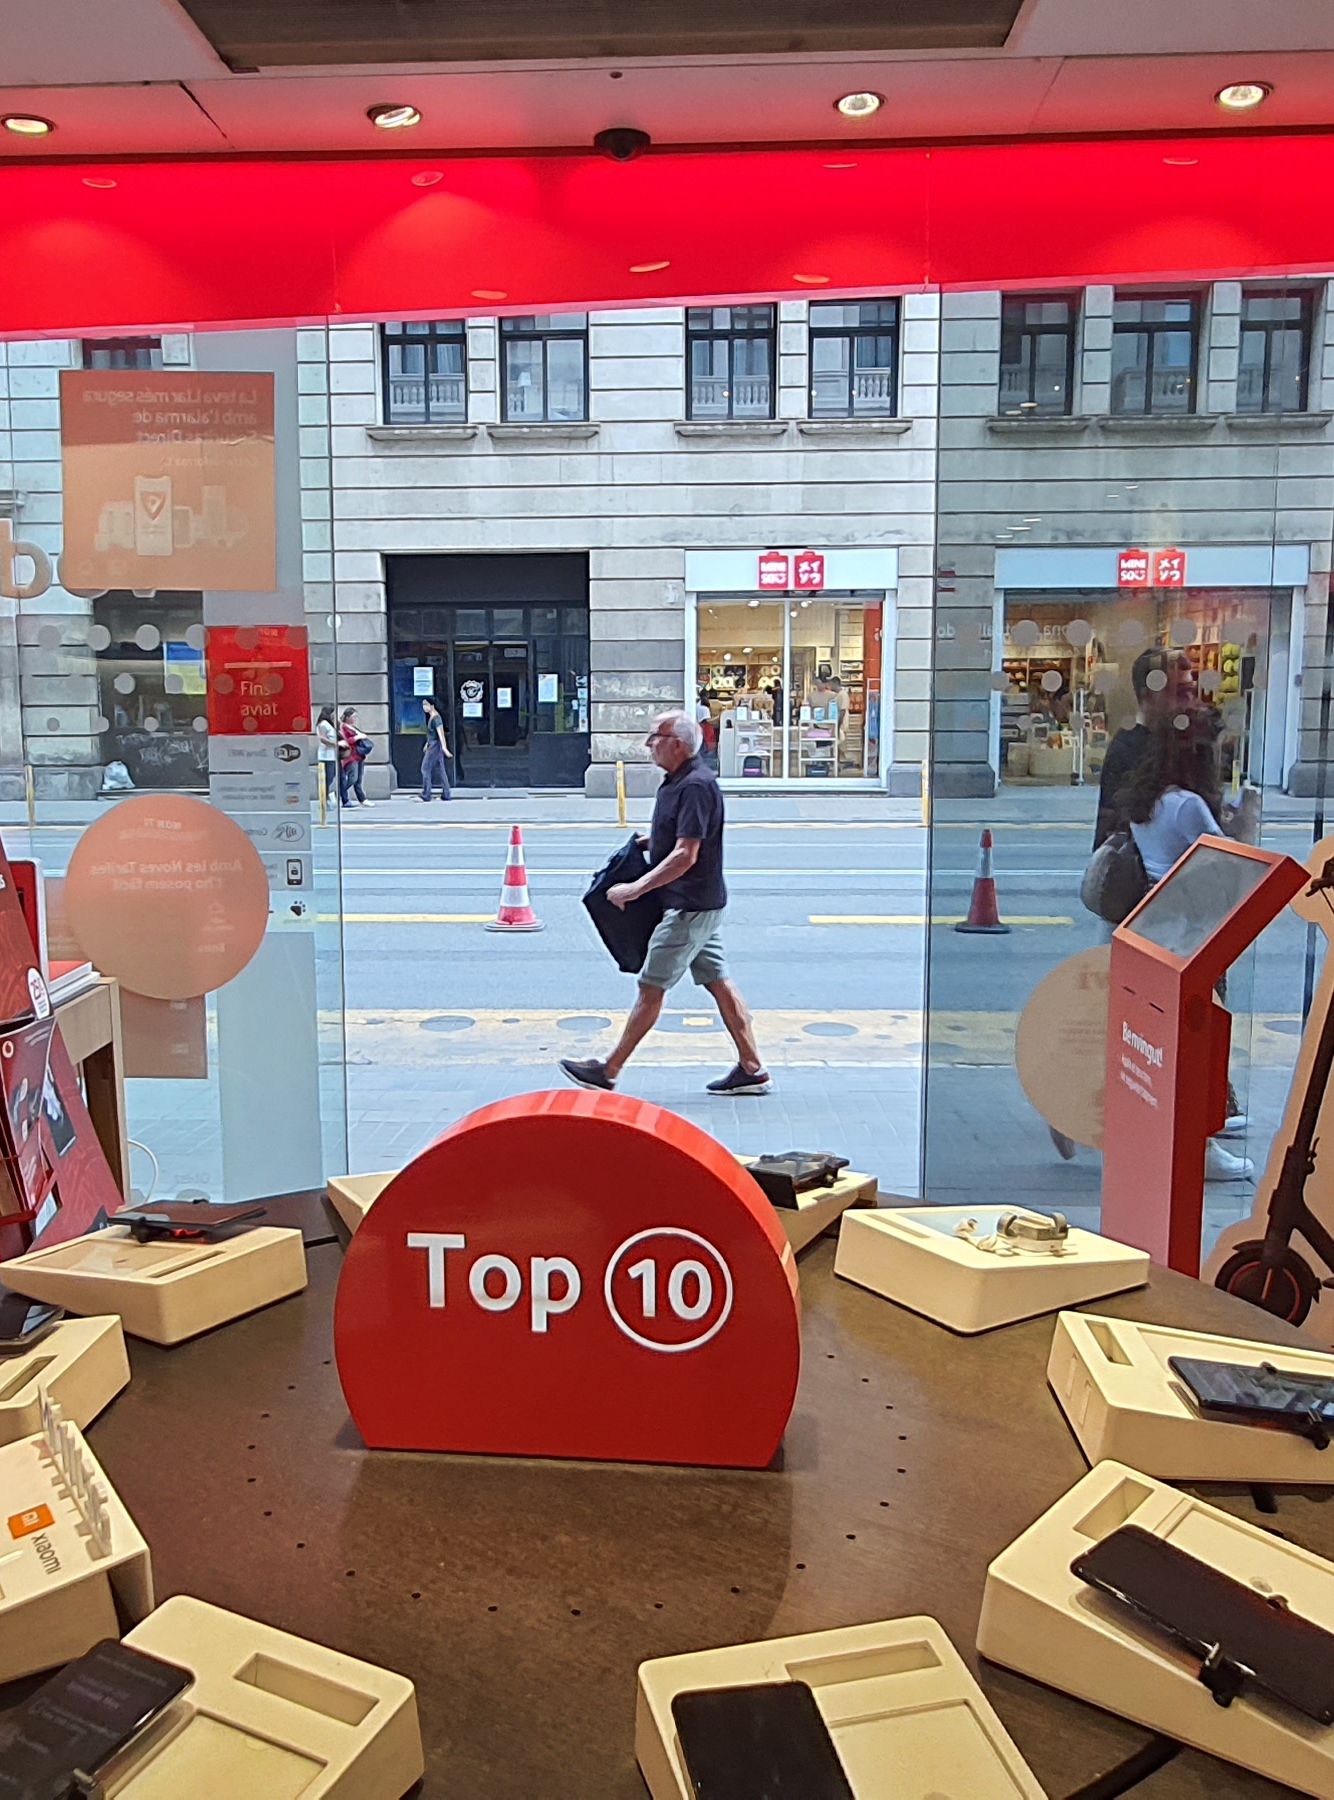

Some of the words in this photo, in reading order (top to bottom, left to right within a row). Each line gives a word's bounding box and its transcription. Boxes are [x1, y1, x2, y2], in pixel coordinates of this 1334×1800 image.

[1121, 558, 1146, 569] MINI
[240, 702, 279, 717] aviat
[407, 1232, 582, 1333] Top
[627, 1257, 713, 1321] 10
[30, 1532, 63, 1575] xiaomi
